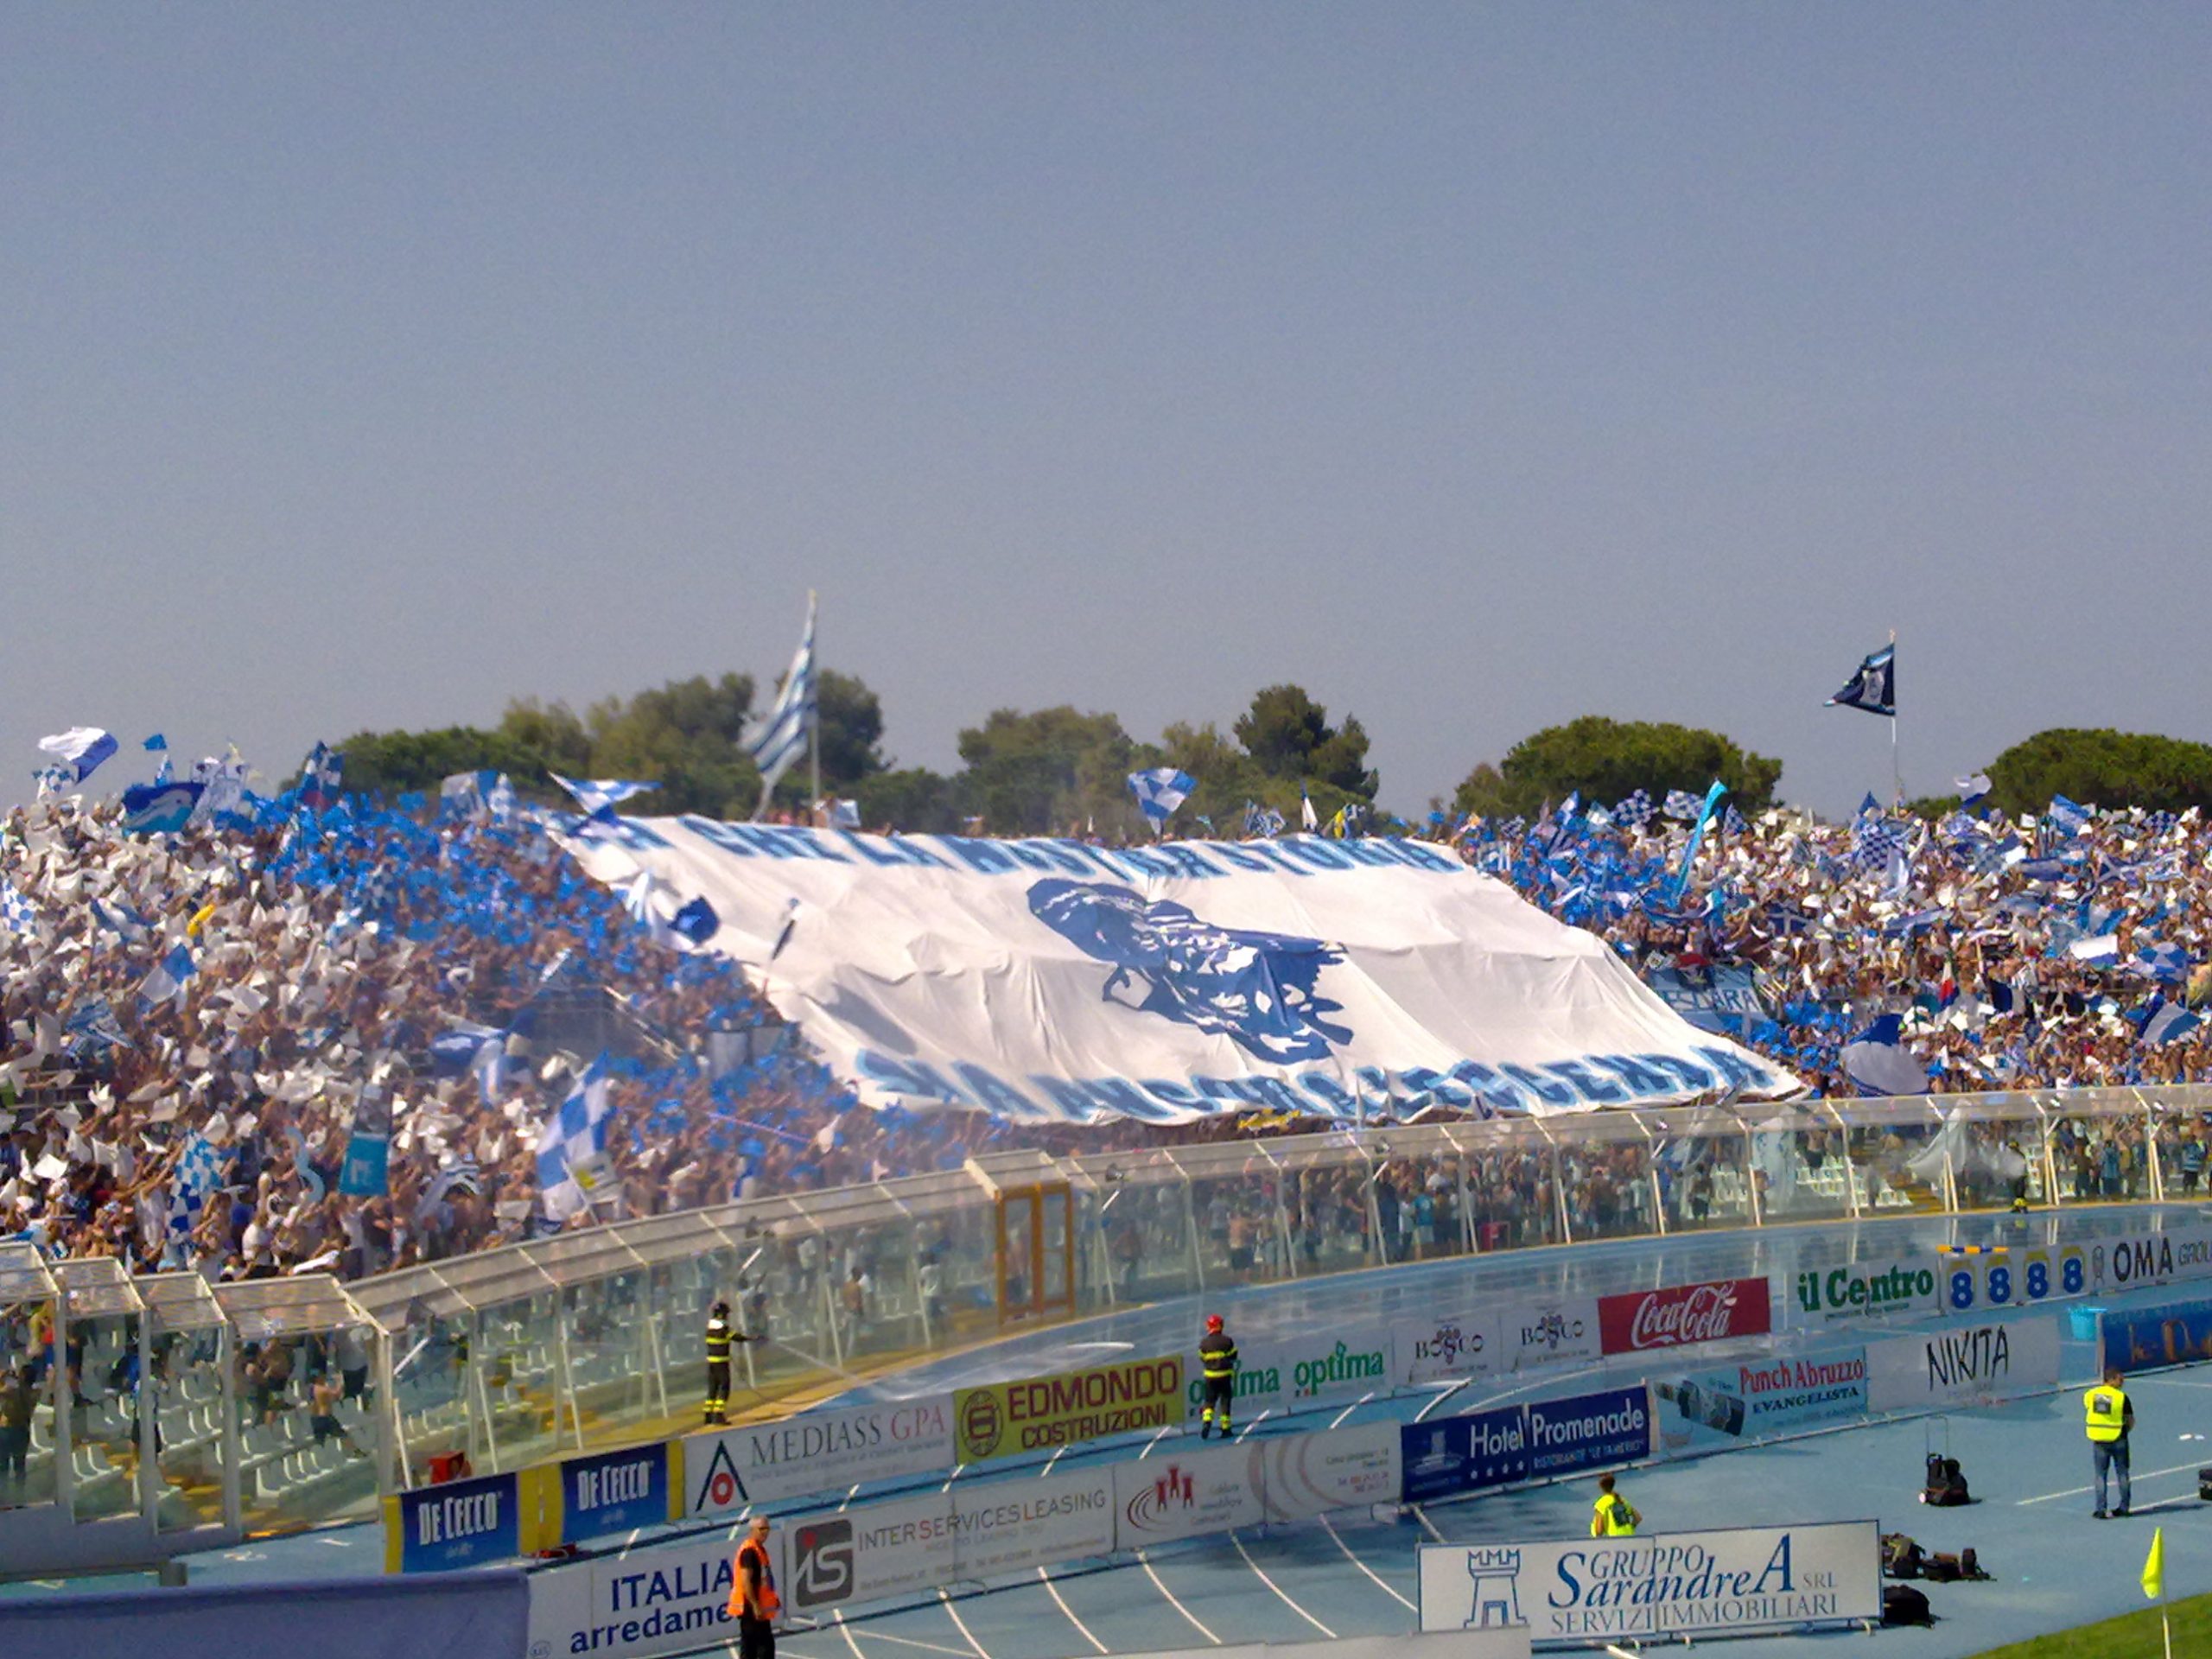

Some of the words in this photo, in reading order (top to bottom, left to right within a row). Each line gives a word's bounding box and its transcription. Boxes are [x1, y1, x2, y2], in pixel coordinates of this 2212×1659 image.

[1951, 1271, 1974, 1309] 8
[1989, 1267, 2012, 1303] 8
[2027, 1262, 2049, 1298] 8
[2063, 1257, 2084, 1294] 8
[2113, 1236, 2174, 1283] OMA
[1797, 1272, 1821, 1312] il
[1826, 1264, 1934, 1307] Centro
[1294, 1340, 1385, 1395] optima
[1738, 1360, 1792, 1395] Punch
[1795, 1357, 1865, 1389] Abruzzo
[1926, 1325, 2009, 1391] NIKITA
[1007, 1360, 1179, 1422] EDMONDO
[1752, 1385, 1859, 1414] EVANGELISTA
[751, 1414, 882, 1468] MEDIASS
[891, 1405, 946, 1441] GPA
[1021, 1402, 1166, 1450] COSTRUZIONI
[1471, 1414, 1525, 1459] Hotel
[1531, 1397, 1645, 1447] Promenade
[1548, 1533, 1796, 1609] SarandreA
[1803, 1571, 1838, 1590] SRL
[1590, 1543, 1705, 1580] GRUPPO
[1551, 1606, 1653, 1636] SERVIZI
[1662, 1592, 1838, 1627] IMMOBILIARI
